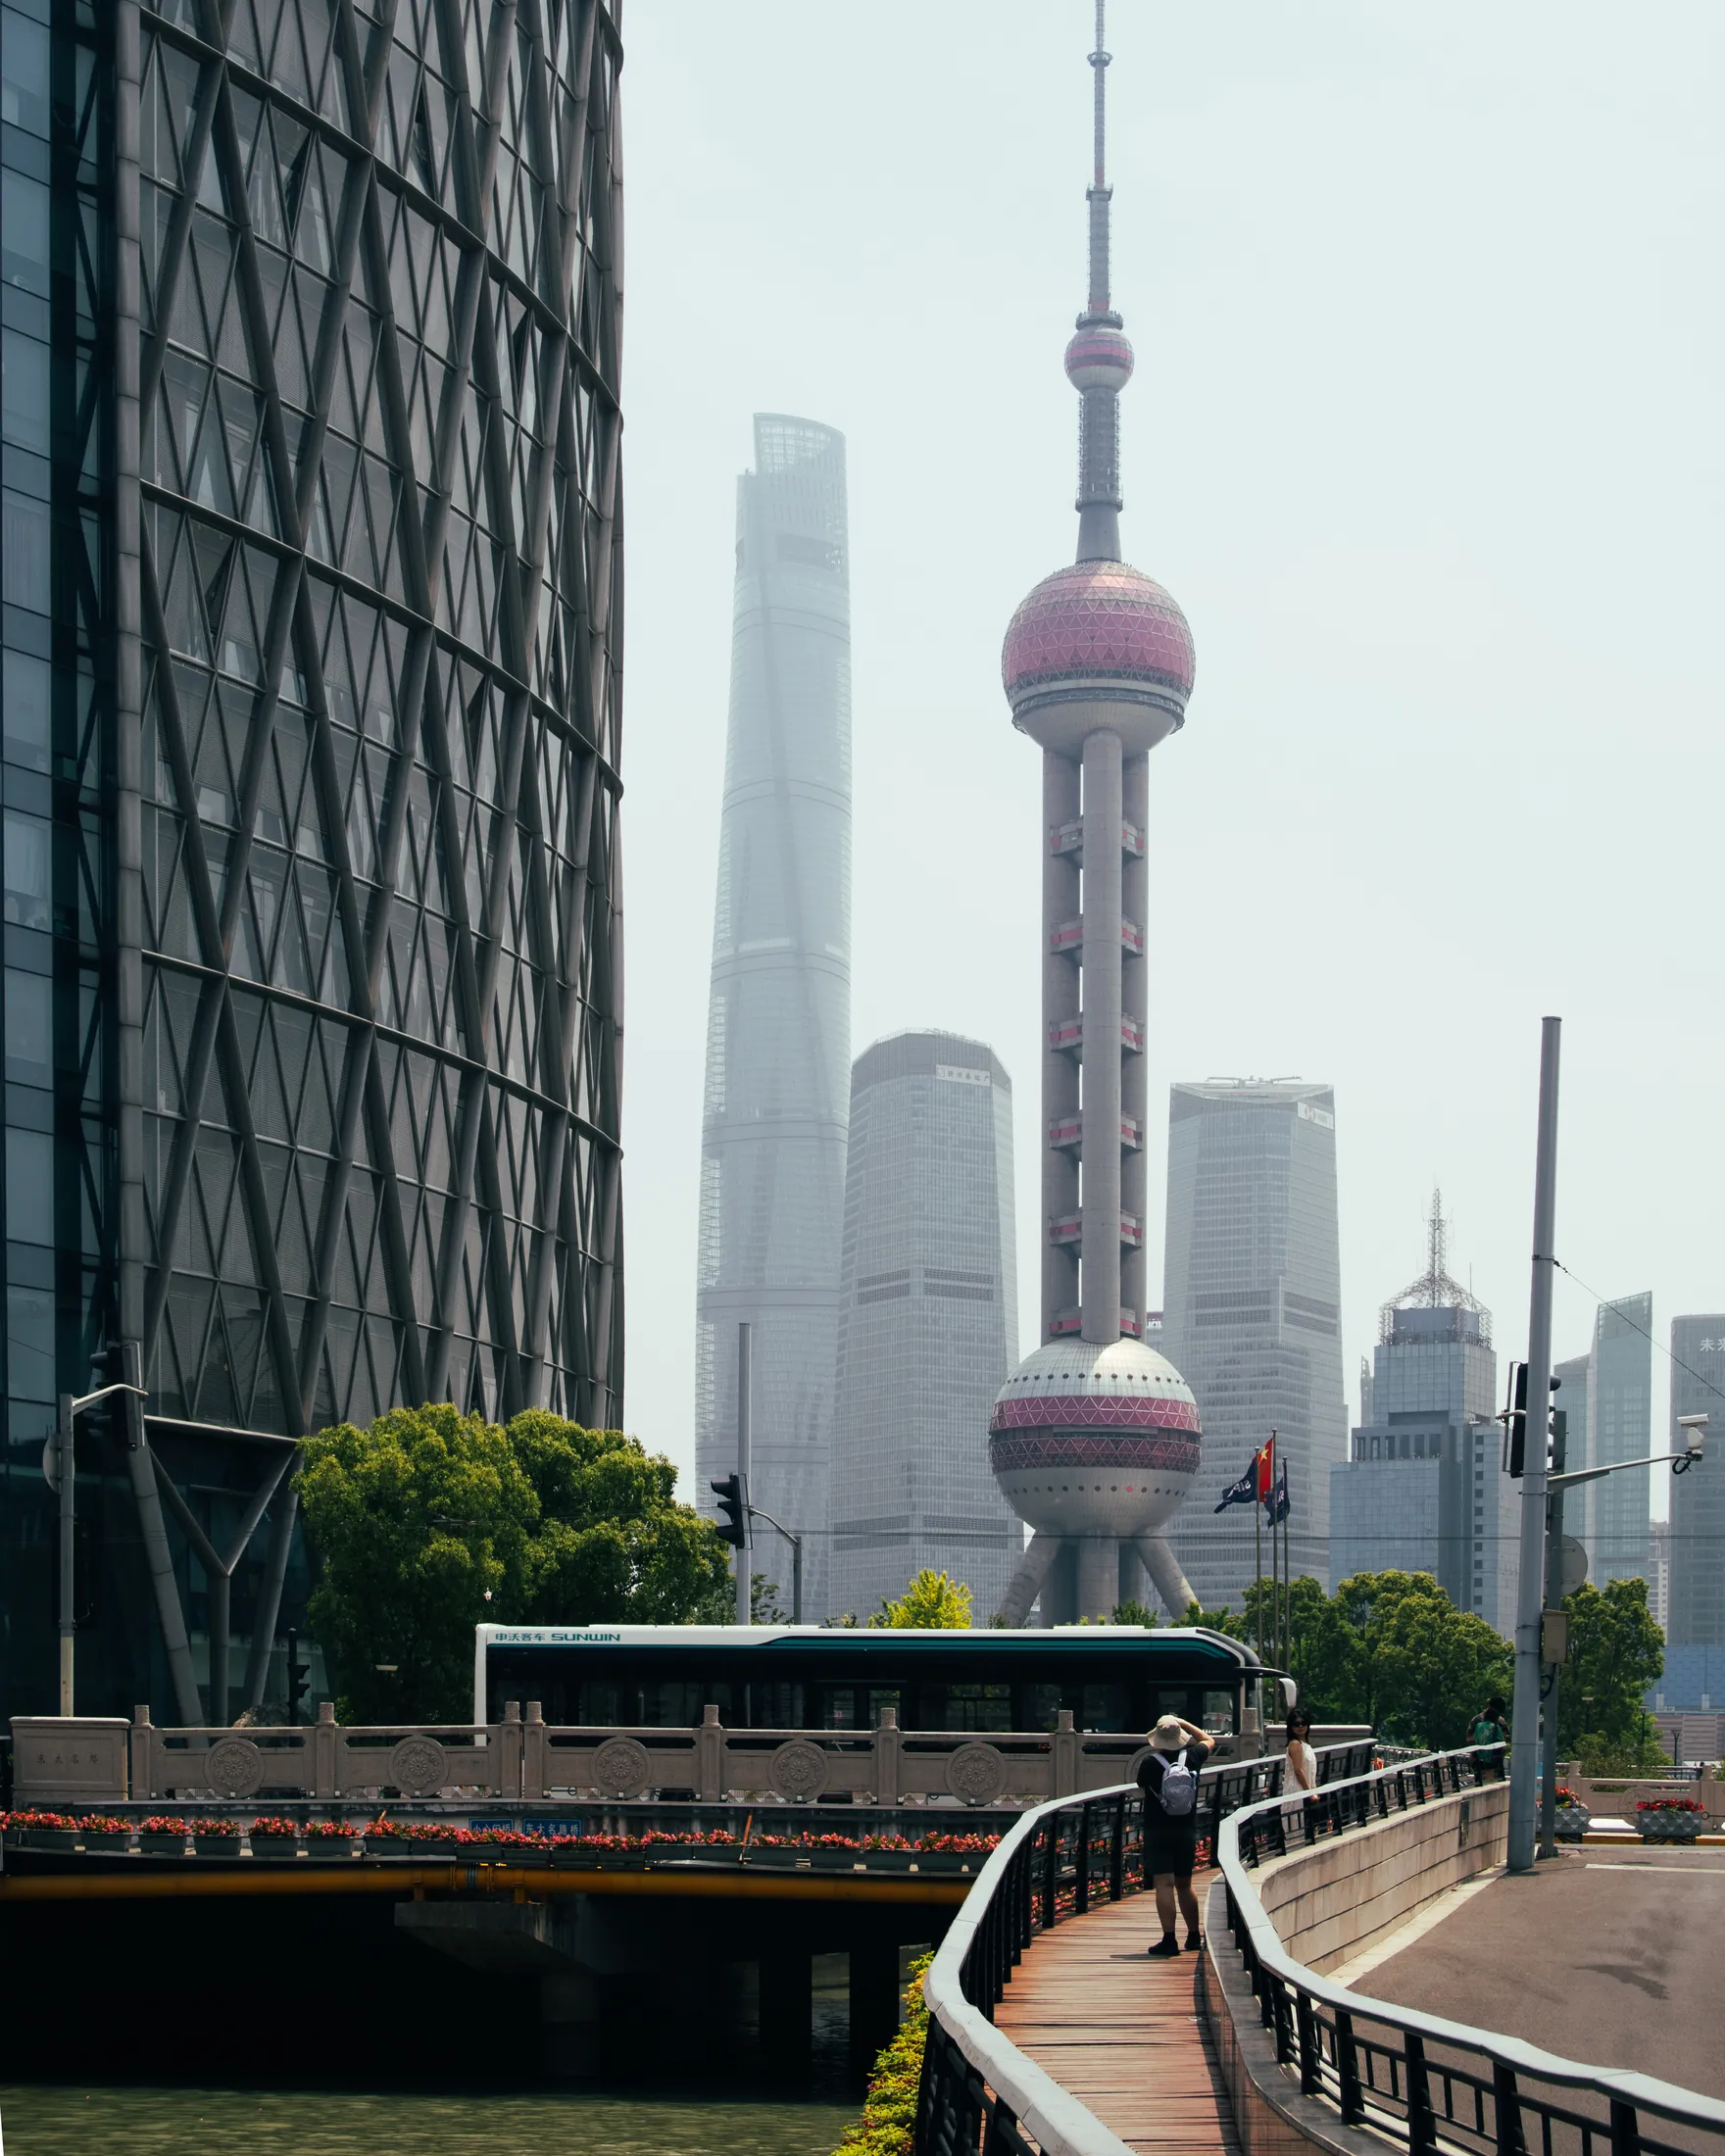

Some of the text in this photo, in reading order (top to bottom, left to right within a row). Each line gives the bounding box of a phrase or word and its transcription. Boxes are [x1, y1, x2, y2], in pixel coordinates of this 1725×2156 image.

[495, 1633, 621, 1642] 申沃客车 SUNWIN
[525, 1823, 579, 1836] 东大名路桥
